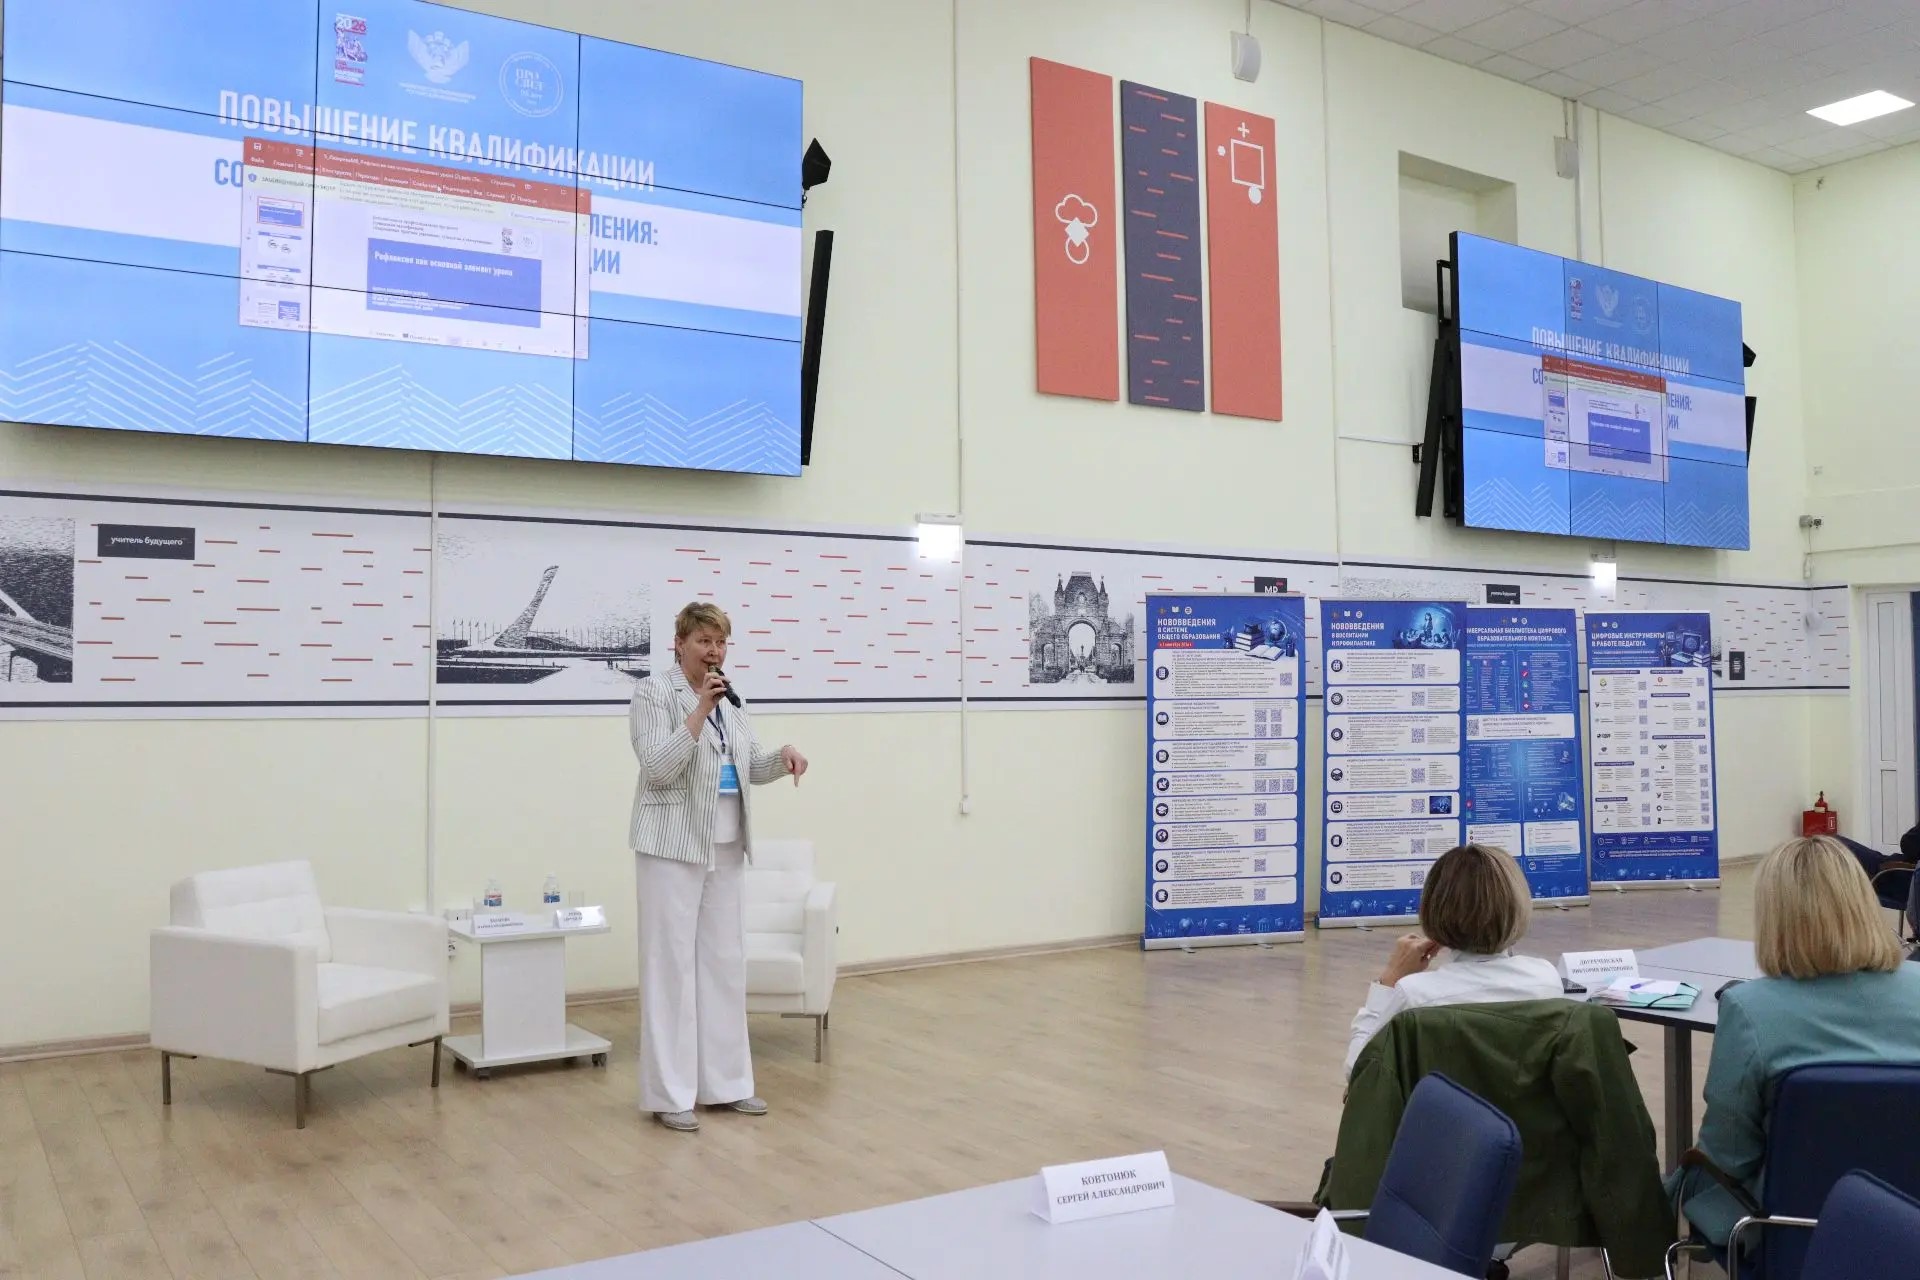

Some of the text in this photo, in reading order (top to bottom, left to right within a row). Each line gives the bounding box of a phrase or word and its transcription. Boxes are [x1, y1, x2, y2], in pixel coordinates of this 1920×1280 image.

[336, 16, 367, 32] 2026
[219, 89, 655, 192] ПОВЫШЕНИЕ КВАЛИФИКАЦИИ
[1532, 326, 1690, 377] ПОВЫШЕНИЕ КВАЛИФИКАЦИИ
[111, 536, 183, 546] учитель будущего
[1157, 618, 1217, 627] НОВОВВЕДЕНИЯ
[1331, 622, 1384, 631] НОВОВВЕДЕНИЯ
[1081, 1169, 1137, 1186] КОВТОНЮК
[1057, 1181, 1165, 1205] СЕРГЕЙ АЛЕКСАНДРОВИЧ
